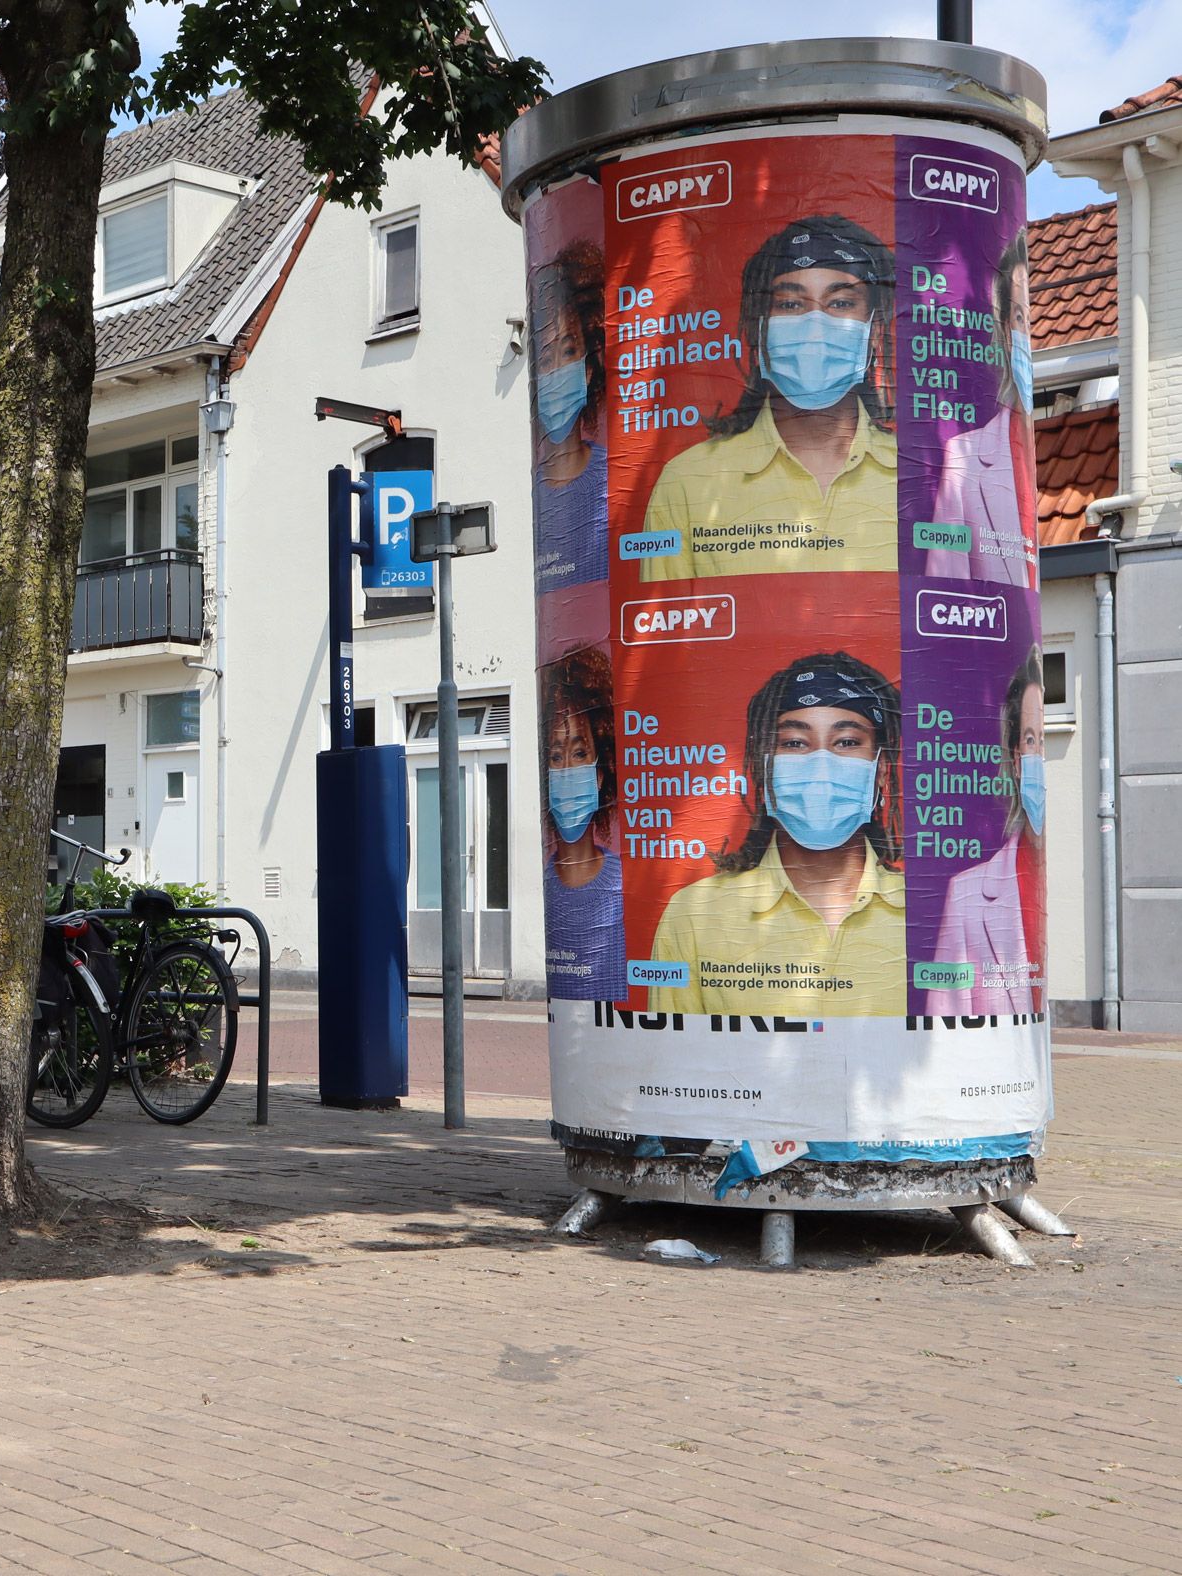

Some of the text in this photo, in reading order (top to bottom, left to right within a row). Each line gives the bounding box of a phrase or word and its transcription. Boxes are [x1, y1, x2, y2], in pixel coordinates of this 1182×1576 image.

[629, 173, 714, 209] CAPPY
[923, 168, 991, 200] CAPPY
[912, 265, 947, 294] De
[618, 285, 654, 313] De
[618, 306, 722, 342] nieuwe
[912, 298, 995, 334] nieuwe
[618, 336, 743, 379] glimlach
[911, 331, 1005, 369] glimlach
[618, 377, 666, 404] van
[912, 364, 958, 391] van
[618, 402, 700, 434] Tirino
[913, 392, 977, 424] Flora
[379, 487, 415, 545] P
[624, 535, 676, 555] Cappy.nl
[692, 524, 773, 541] Maandelijks
[692, 535, 845, 554] bezorgde mondkapjes
[919, 528, 967, 546] Cappy.nl
[979, 542, 1015, 560] bezorgde
[390, 571, 426, 582] 26303
[633, 607, 718, 634] CAPPY
[931, 602, 998, 630] CAPPY
[343, 666, 351, 730] 26303
[623, 710, 659, 737] De
[916, 704, 953, 731] De
[623, 741, 727, 766] nieuwe
[916, 736, 1003, 764] nieuwe
[624, 769, 747, 803] glimlach
[915, 767, 1015, 801] glimlach
[624, 807, 673, 829] van
[916, 803, 963, 826] van
[624, 833, 707, 860] Tirino
[916, 832, 982, 860] Flora
[631, 966, 683, 983] Cappy.nl
[700, 960, 781, 976] Maandelijks
[920, 969, 969, 984] Cappy.nl
[700, 976, 854, 992] bezorgde mondkapjes
[982, 976, 1018, 991] bezorgde
[639, 1085, 762, 1100] ROSH-STUDIOS.COM
[960, 1079, 1035, 1097] ROSH-STUDIOS.COM
